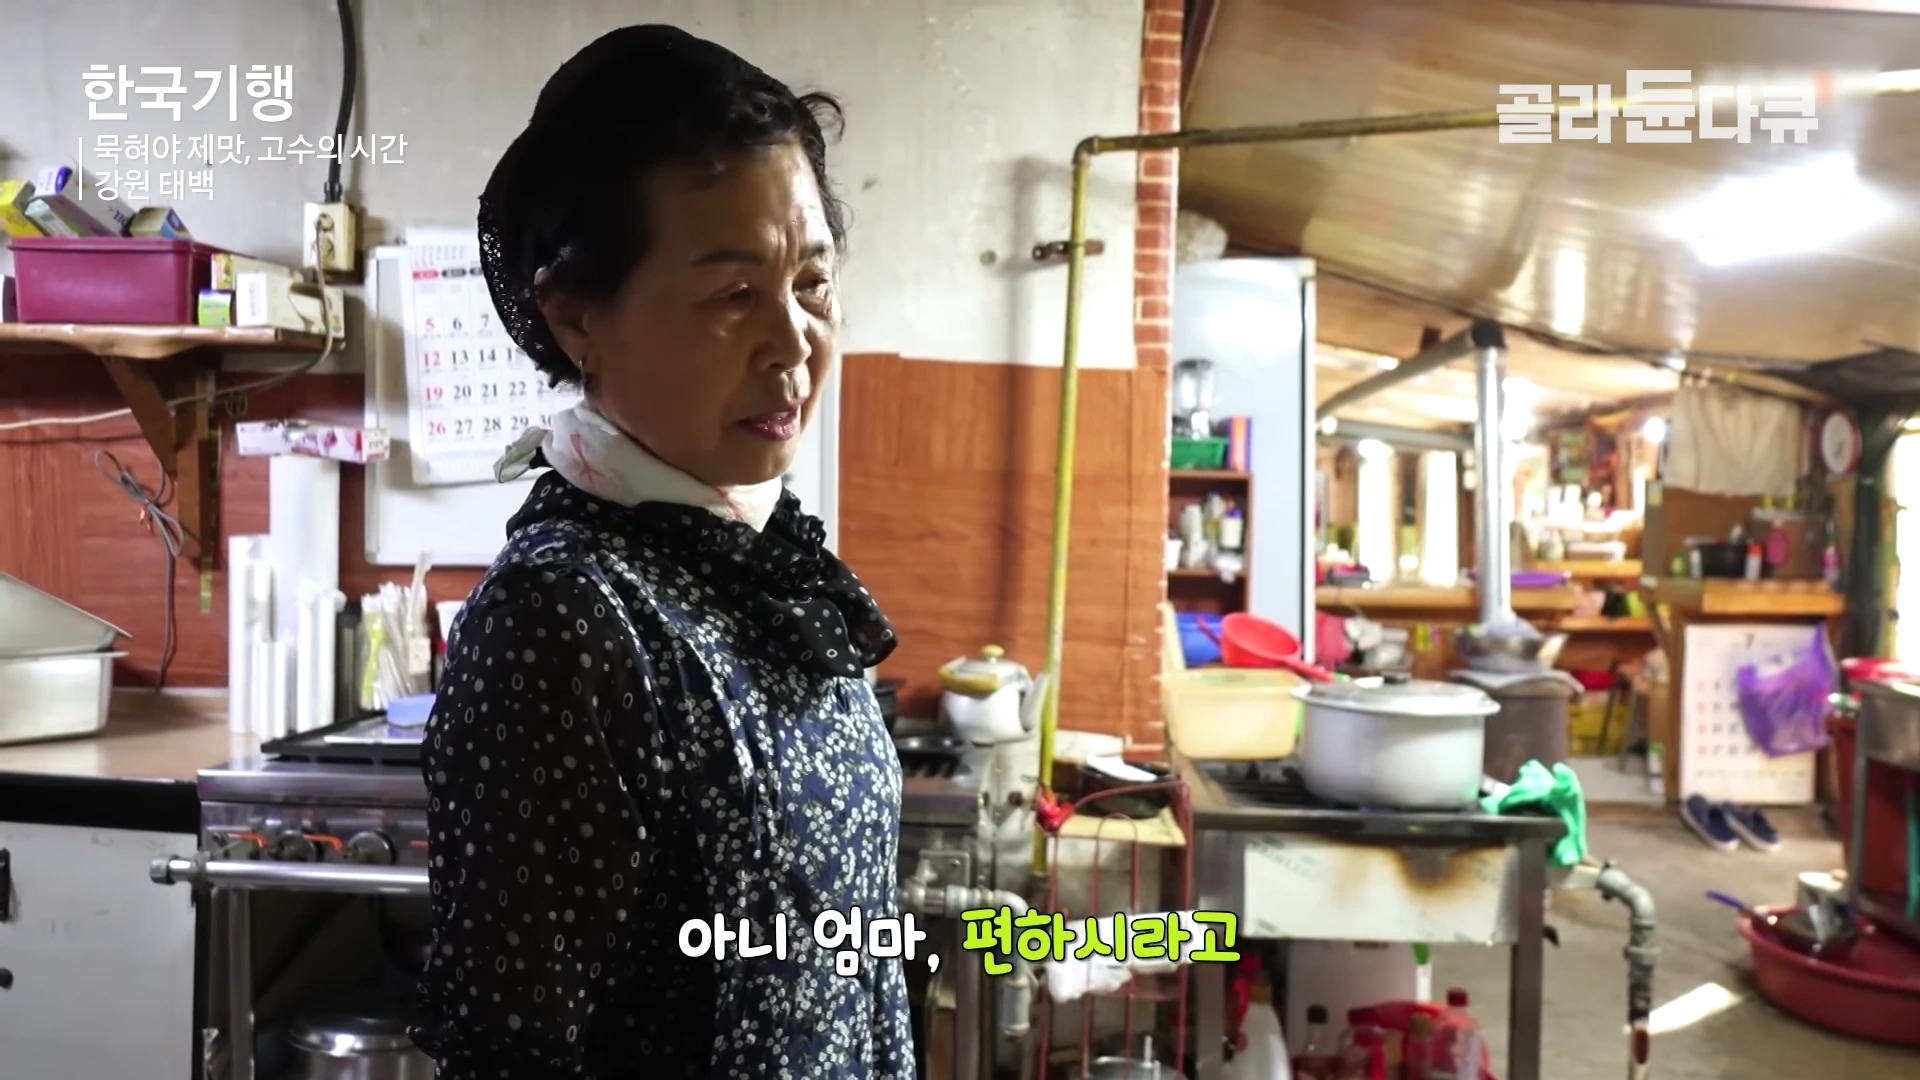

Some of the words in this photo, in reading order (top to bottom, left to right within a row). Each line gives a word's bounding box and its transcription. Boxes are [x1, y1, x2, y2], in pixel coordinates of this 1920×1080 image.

[425, 318, 435, 331] 5
[453, 317, 462, 331] 6
[481, 314, 489, 329] 7
[423, 352, 441, 367] 12
[451, 350, 469, 365] 13
[479, 348, 497, 362] 14
[425, 386, 443, 400] 19
[453, 384, 472, 399] 20
[481, 382, 498, 397] 21
[509, 381, 527, 396] 22
[427, 421, 446, 436] 26
[455, 419, 473, 434] 27
[483, 417, 502, 432] 28
[511, 415, 529, 430] 29
